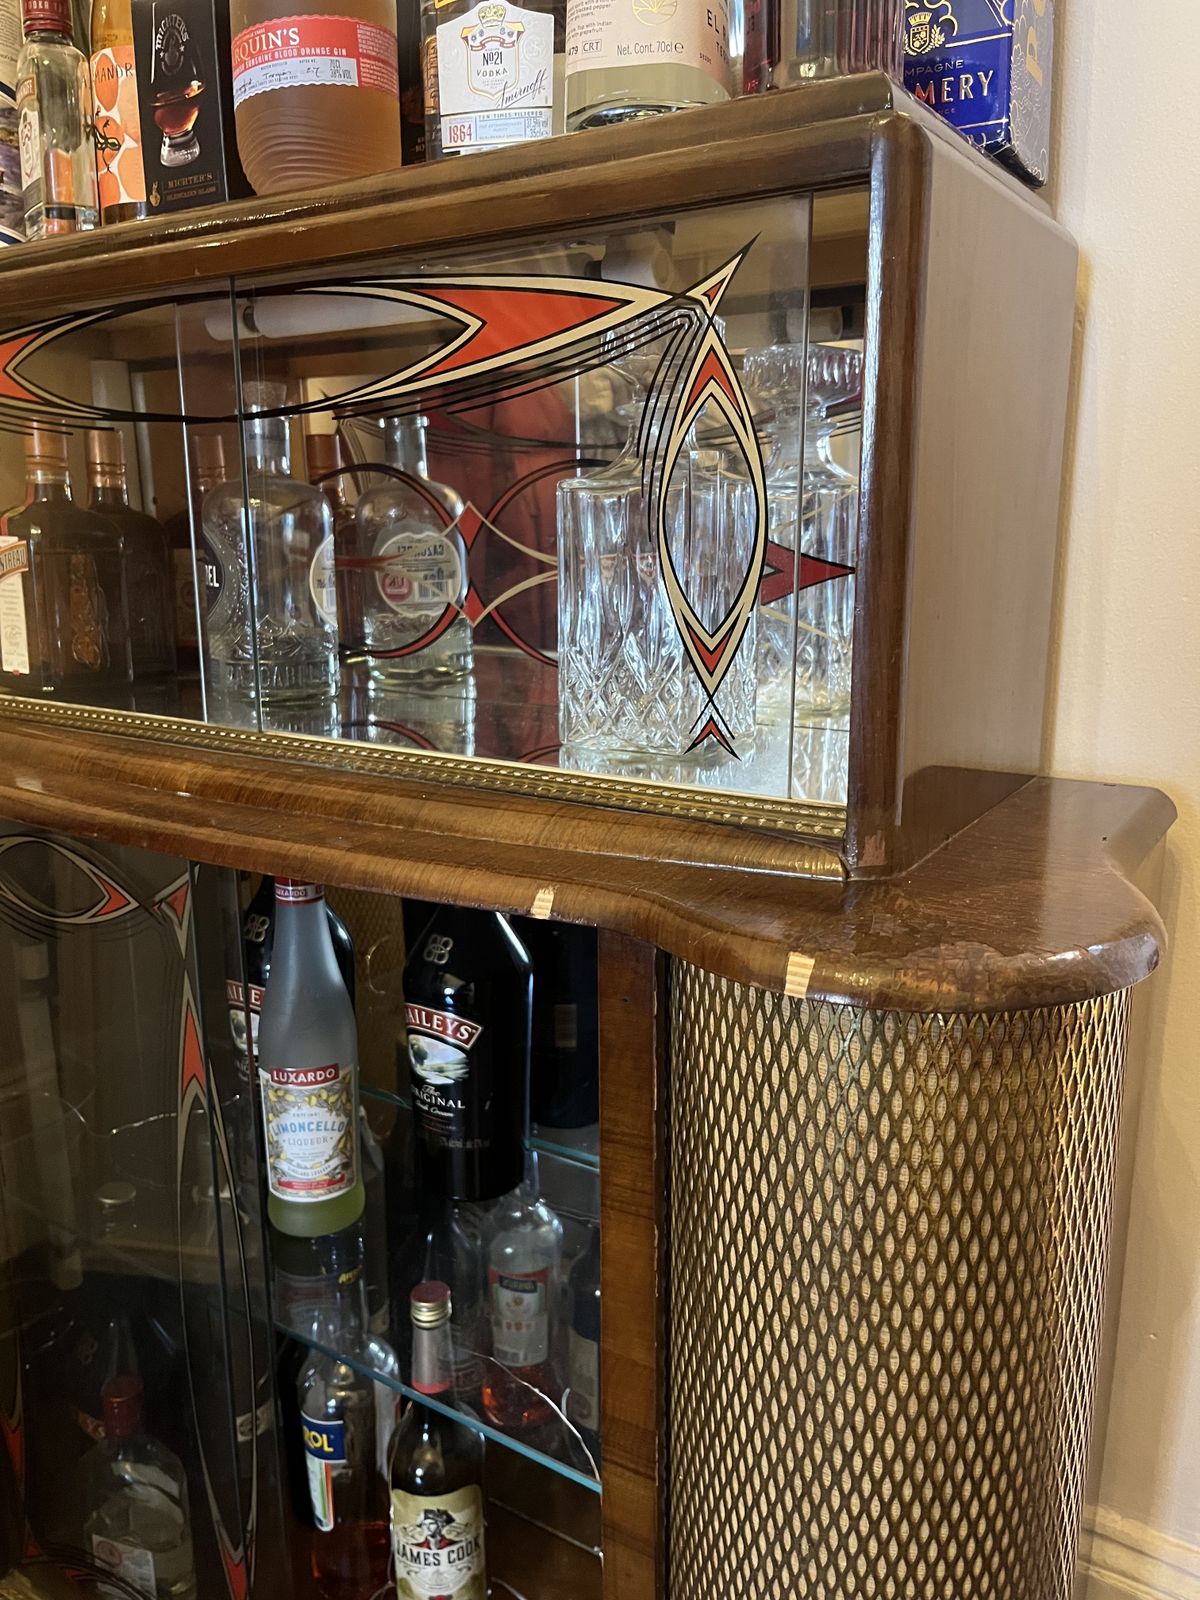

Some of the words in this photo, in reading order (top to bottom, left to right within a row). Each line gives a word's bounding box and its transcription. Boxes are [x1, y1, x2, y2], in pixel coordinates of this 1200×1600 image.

[706, 8, 720, 34] EL
[274, 48, 298, 59] BLOOD
[300, 47, 330, 56] ORANGE
[333, 48, 347, 56] GIN
[583, 41, 600, 52] CRT
[616, 44, 632, 56] Net.
[634, 41, 655, 55] Cont.
[656, 40, 673, 53] 70cl
[476, 68, 508, 77] VODKA
[905, 59, 965, 77] MPAGNE
[497, 68, 548, 109] Smirnoff
[914, 70, 994, 105] MERY
[449, 123, 473, 144] 1864
[168, 173, 213, 188] MICHTER'S
[273, 1068, 336, 1083] LUXARDO
[271, 1121, 346, 1137] LIMONCELLO
[288, 1136, 329, 1147] LIQUEUR
[397, 1544, 440, 1567] JAMES
[447, 1537, 481, 1565] COOK
